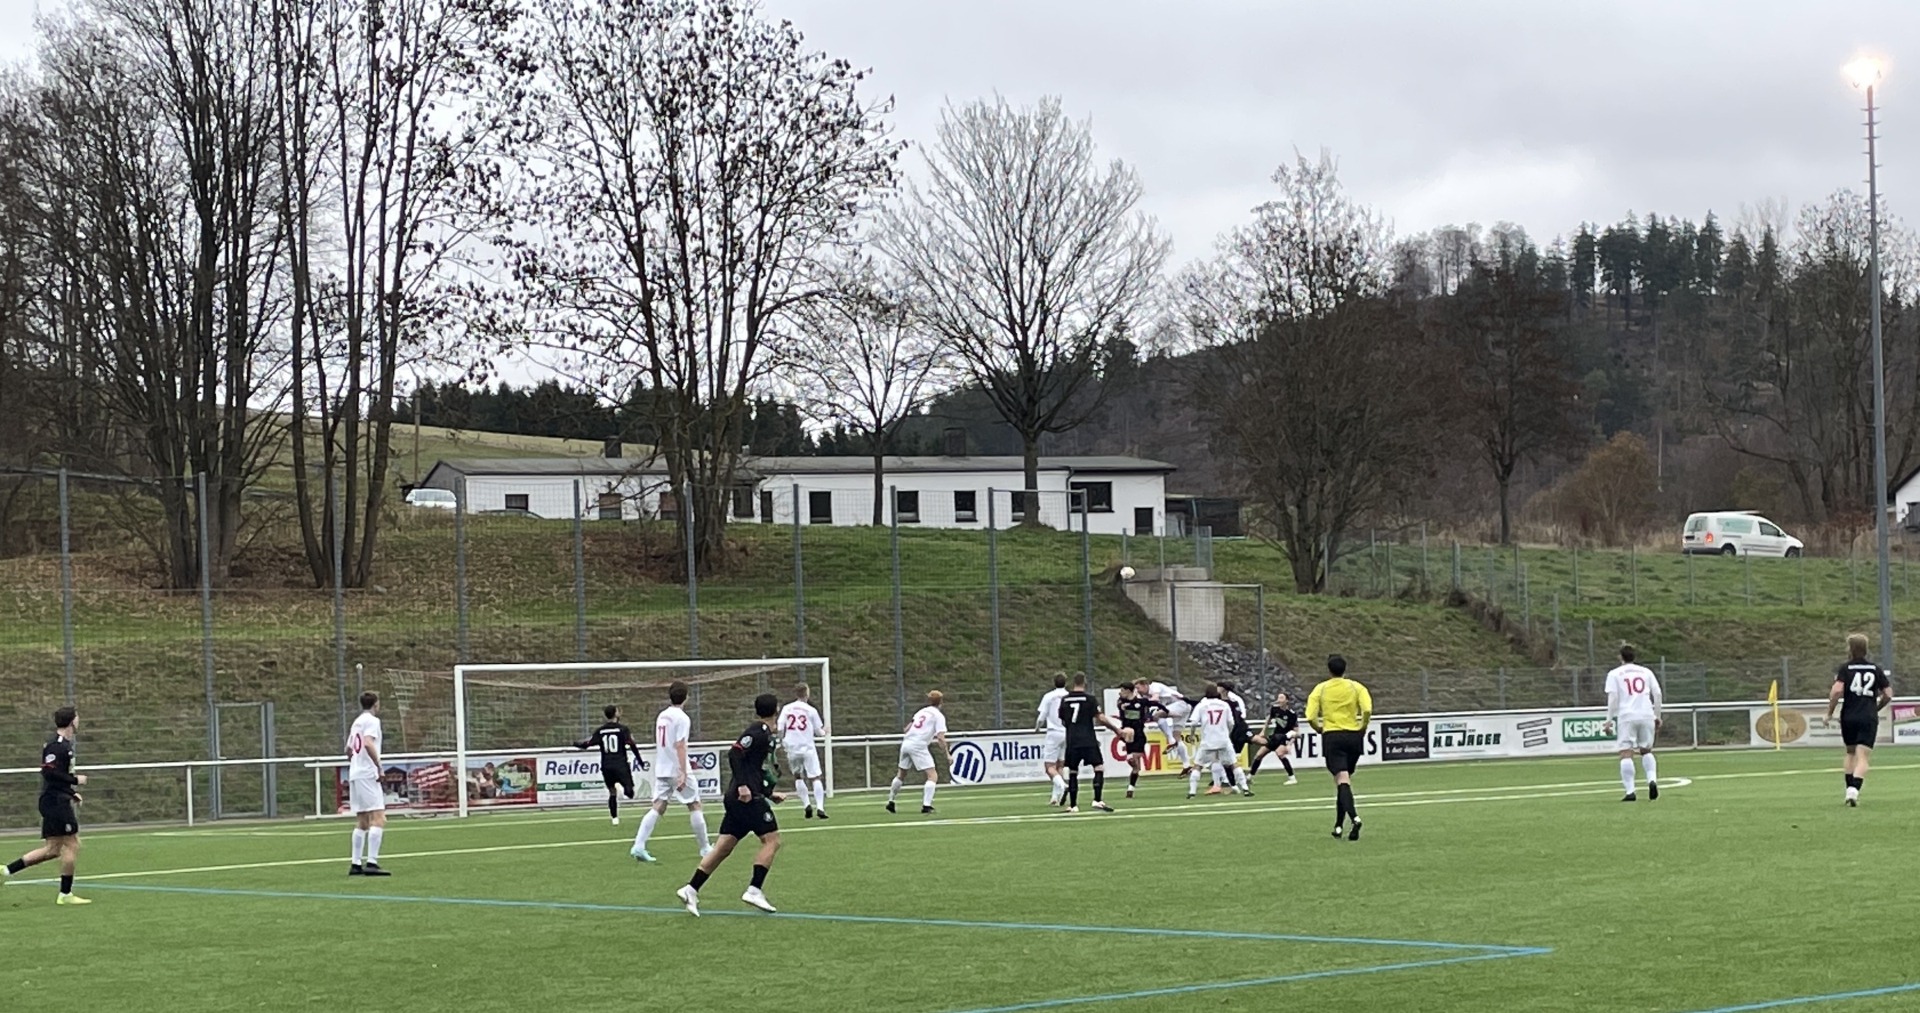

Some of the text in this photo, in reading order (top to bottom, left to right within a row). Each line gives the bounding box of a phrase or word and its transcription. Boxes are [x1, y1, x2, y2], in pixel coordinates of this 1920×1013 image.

[1624, 677, 1645, 696] 10
[1849, 672, 1875, 696] 42
[914, 715, 926, 729] 3
[1070, 703, 1080, 723] 7
[1207, 709, 1224, 725] 17
[787, 714, 807, 731] 23
[602, 735, 618, 752] 10
[658, 726, 666, 747] 11
